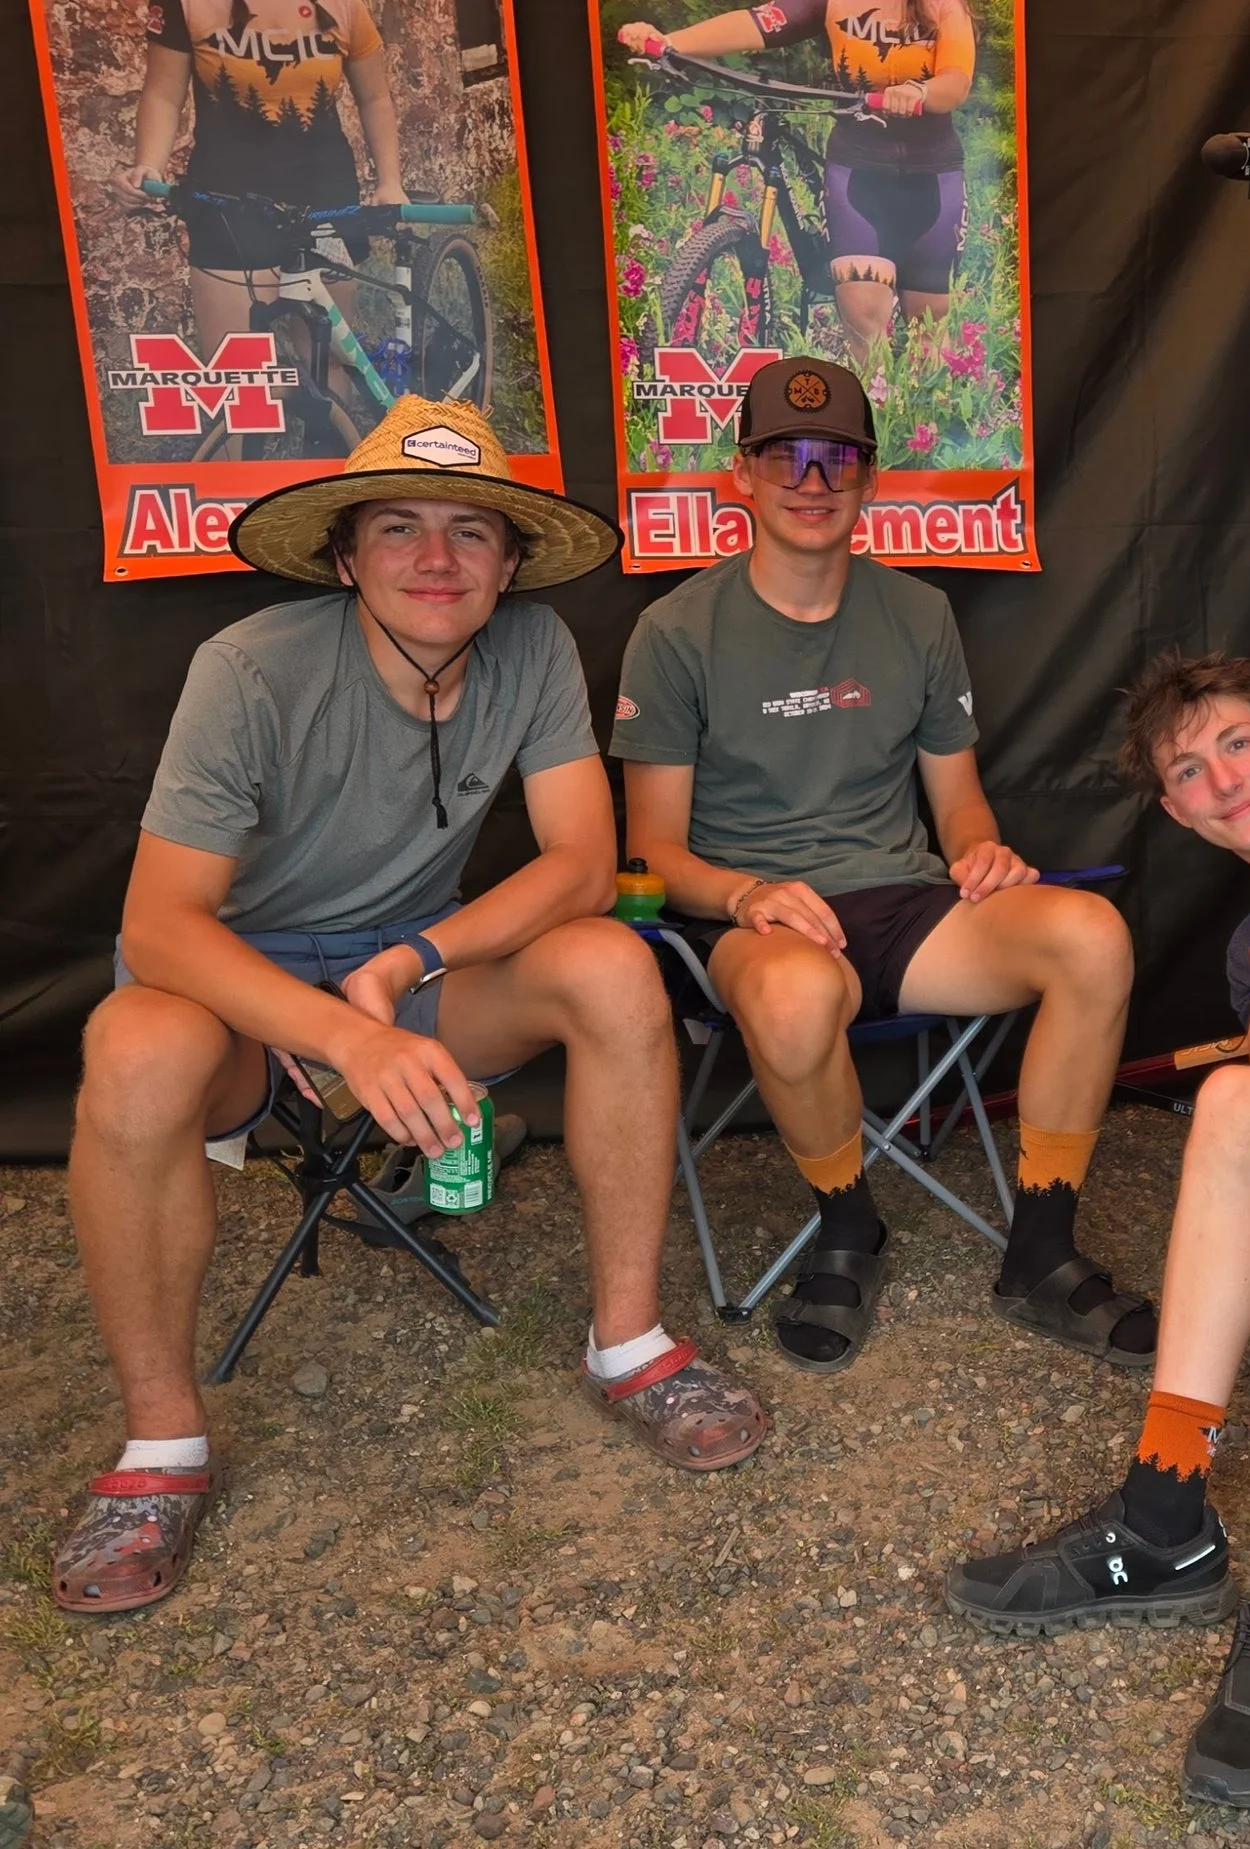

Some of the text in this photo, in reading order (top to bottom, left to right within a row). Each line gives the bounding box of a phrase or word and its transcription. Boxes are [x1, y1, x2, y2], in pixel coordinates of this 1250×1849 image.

[215, 28, 335, 61] MCIC
[110, 371, 298, 387] MARQUETTE
[130, 333, 286, 436] M
[416, 440, 477, 457] certainteed
[631, 491, 754, 557] Ella
